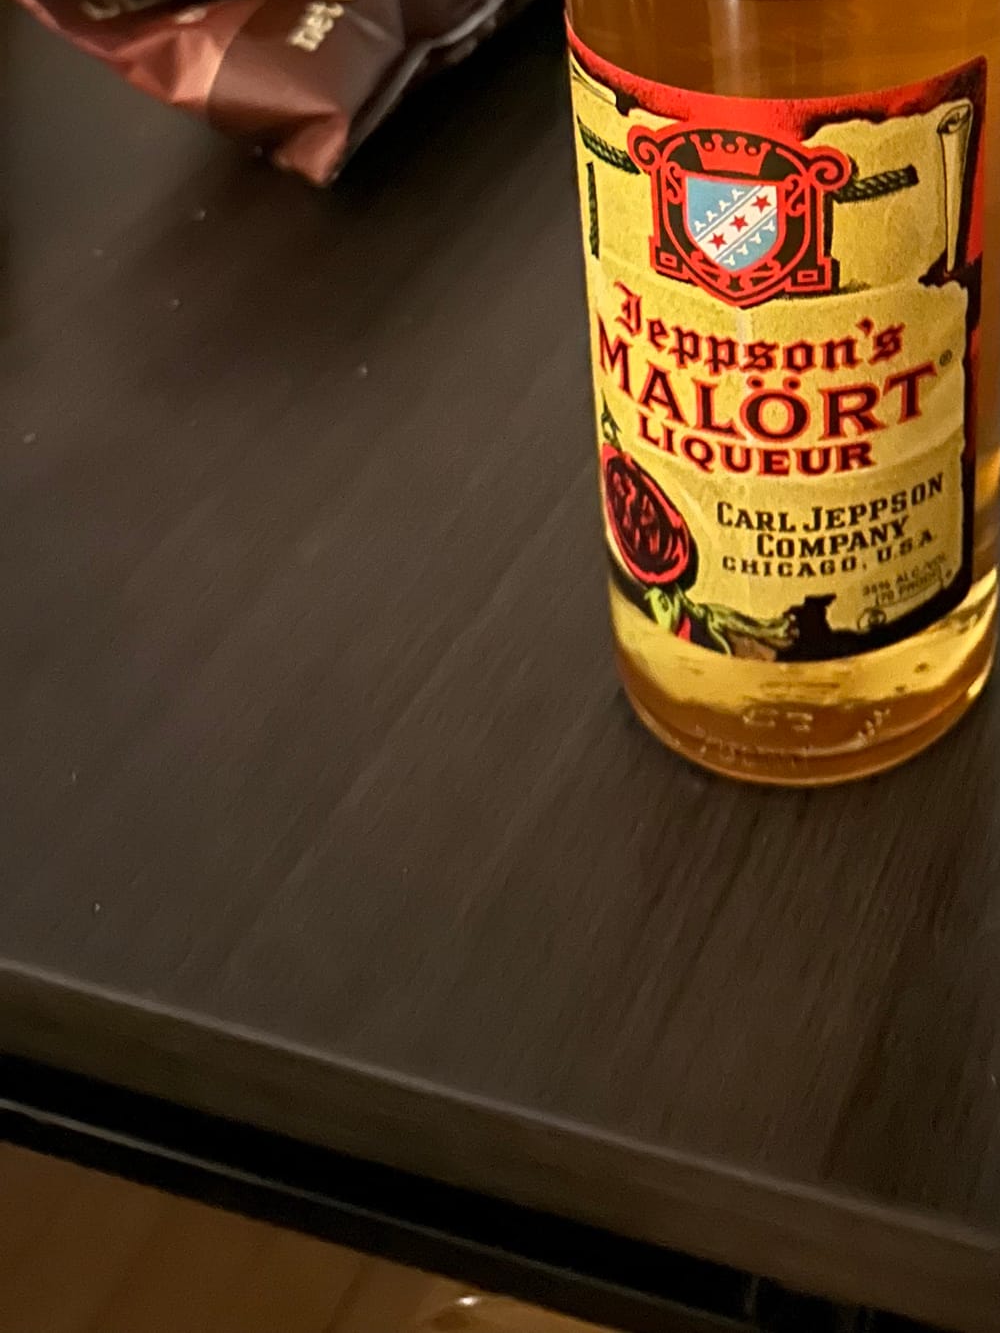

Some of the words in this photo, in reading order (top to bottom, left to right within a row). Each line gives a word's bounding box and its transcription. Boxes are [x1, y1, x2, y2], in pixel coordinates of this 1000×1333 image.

[613, 280, 906, 376] Jeppson's
[597, 315, 938, 444] MALÖRT
[638, 413, 878, 477] LIQUEUR
[716, 500, 797, 534] CARL
[803, 472, 944, 532] JEPPSON
[721, 555, 868, 578] CHICAGO,
[756, 515, 909, 559] COMPANY
